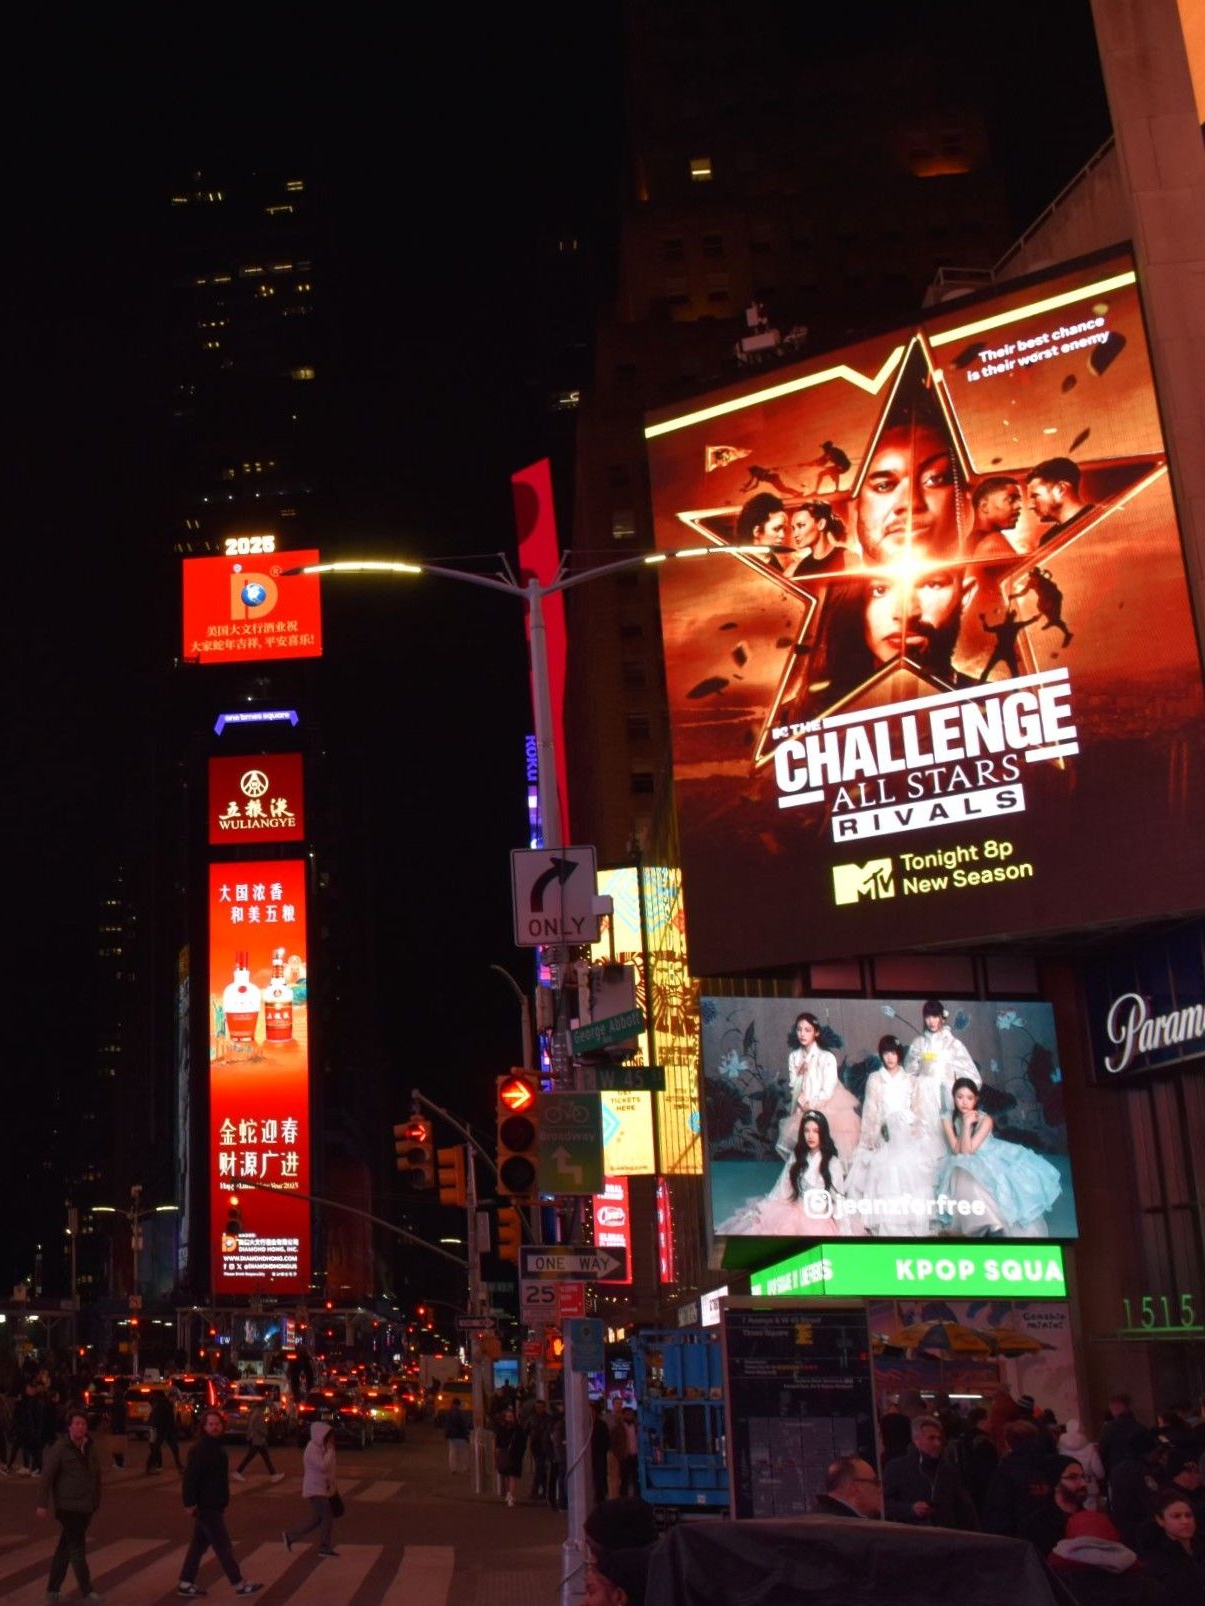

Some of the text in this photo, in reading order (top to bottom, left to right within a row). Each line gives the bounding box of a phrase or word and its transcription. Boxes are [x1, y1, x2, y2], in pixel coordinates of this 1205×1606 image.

[978, 317, 1105, 363] Their best chance
[967, 331, 1110, 382] is their worst enemy
[225, 535, 275, 556] 2025
[774, 683, 1077, 792] CHALLENGE
[832, 753, 1020, 812] ALL STARS
[219, 817, 296, 830] WULIANGYE
[839, 789, 1018, 836] RIVALS
[899, 839, 1013, 872] Tonight 8p
[219, 883, 283, 902] 大国浓香
[902, 862, 1033, 895] New Season
[230, 904, 295, 923] 和美五粮
[528, 916, 585, 937] ONLY
[573, 1012, 640, 1044] George Abbott
[599, 1070, 616, 1088] W
[624, 1070, 644, 1088] 45
[219, 1117, 299, 1145] 金蛇迎春
[219, 1150, 299, 1179] 财源广进
[536, 1257, 610, 1270] ONE WAY
[895, 1259, 1064, 1281] KPOP SQUA
[525, 1285, 555, 1303] 25
[1123, 1294, 1195, 1330] 1515
